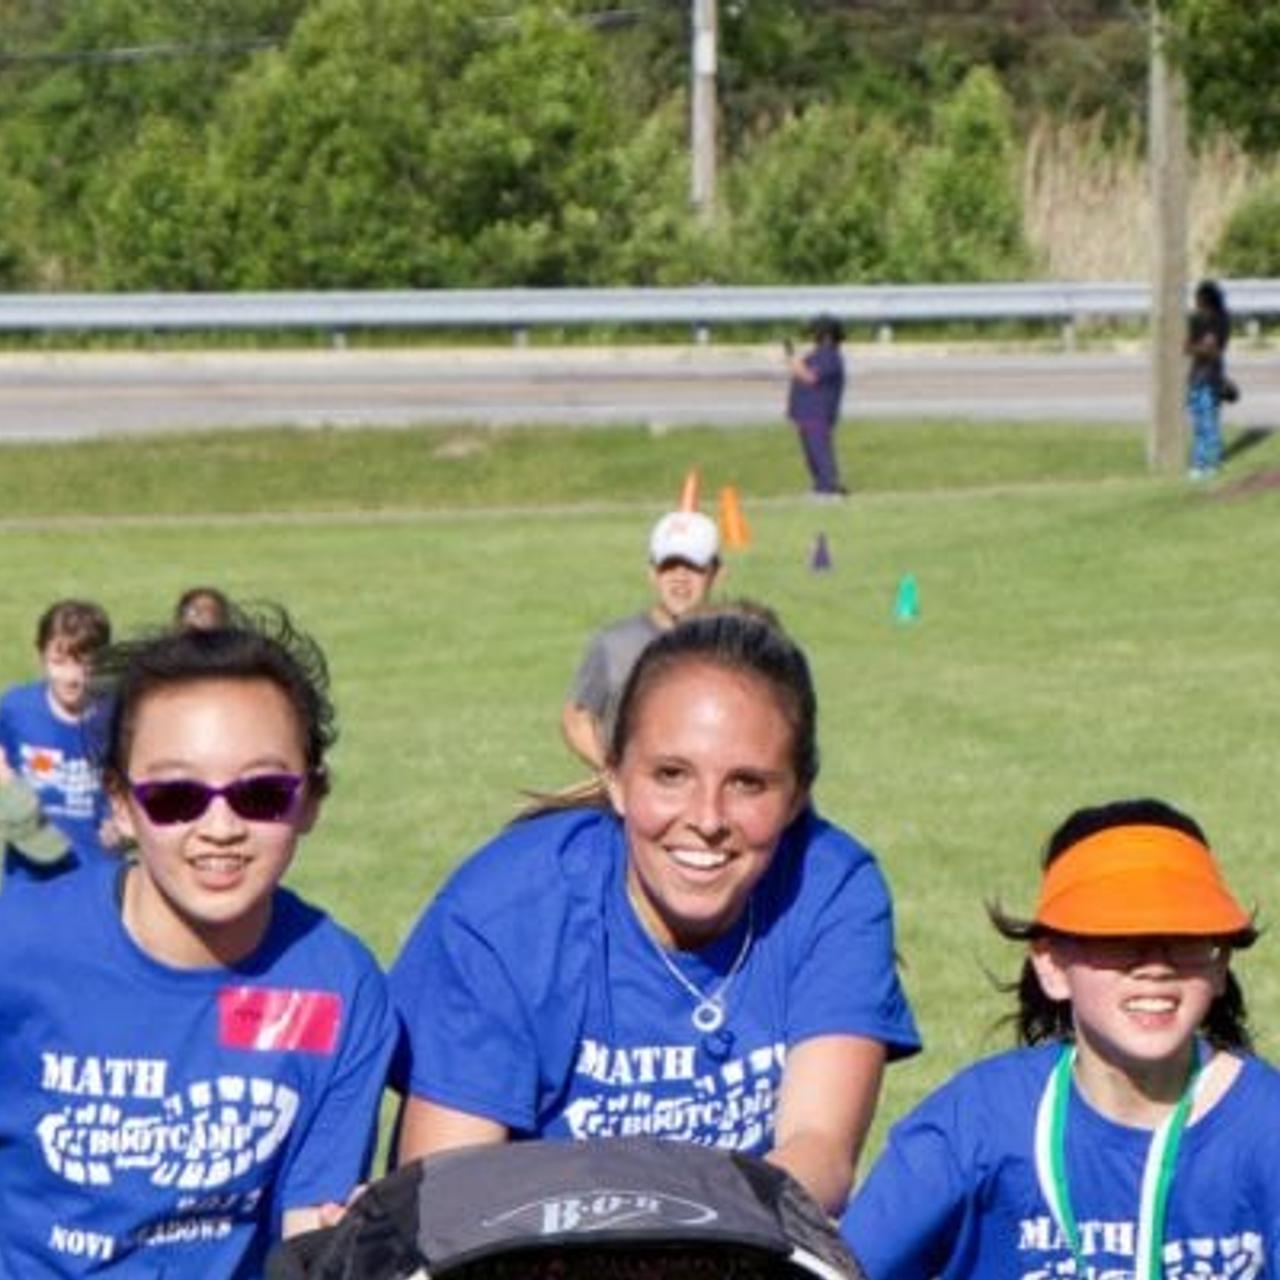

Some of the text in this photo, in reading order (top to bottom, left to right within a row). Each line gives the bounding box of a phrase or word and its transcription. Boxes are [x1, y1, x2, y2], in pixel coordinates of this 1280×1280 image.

[40, 1051, 167, 1099] MATH
[575, 1039, 697, 1085] MATH
[87, 1119, 254, 1160] BOOTCAMP
[50, 1225, 115, 1260] NOVI
